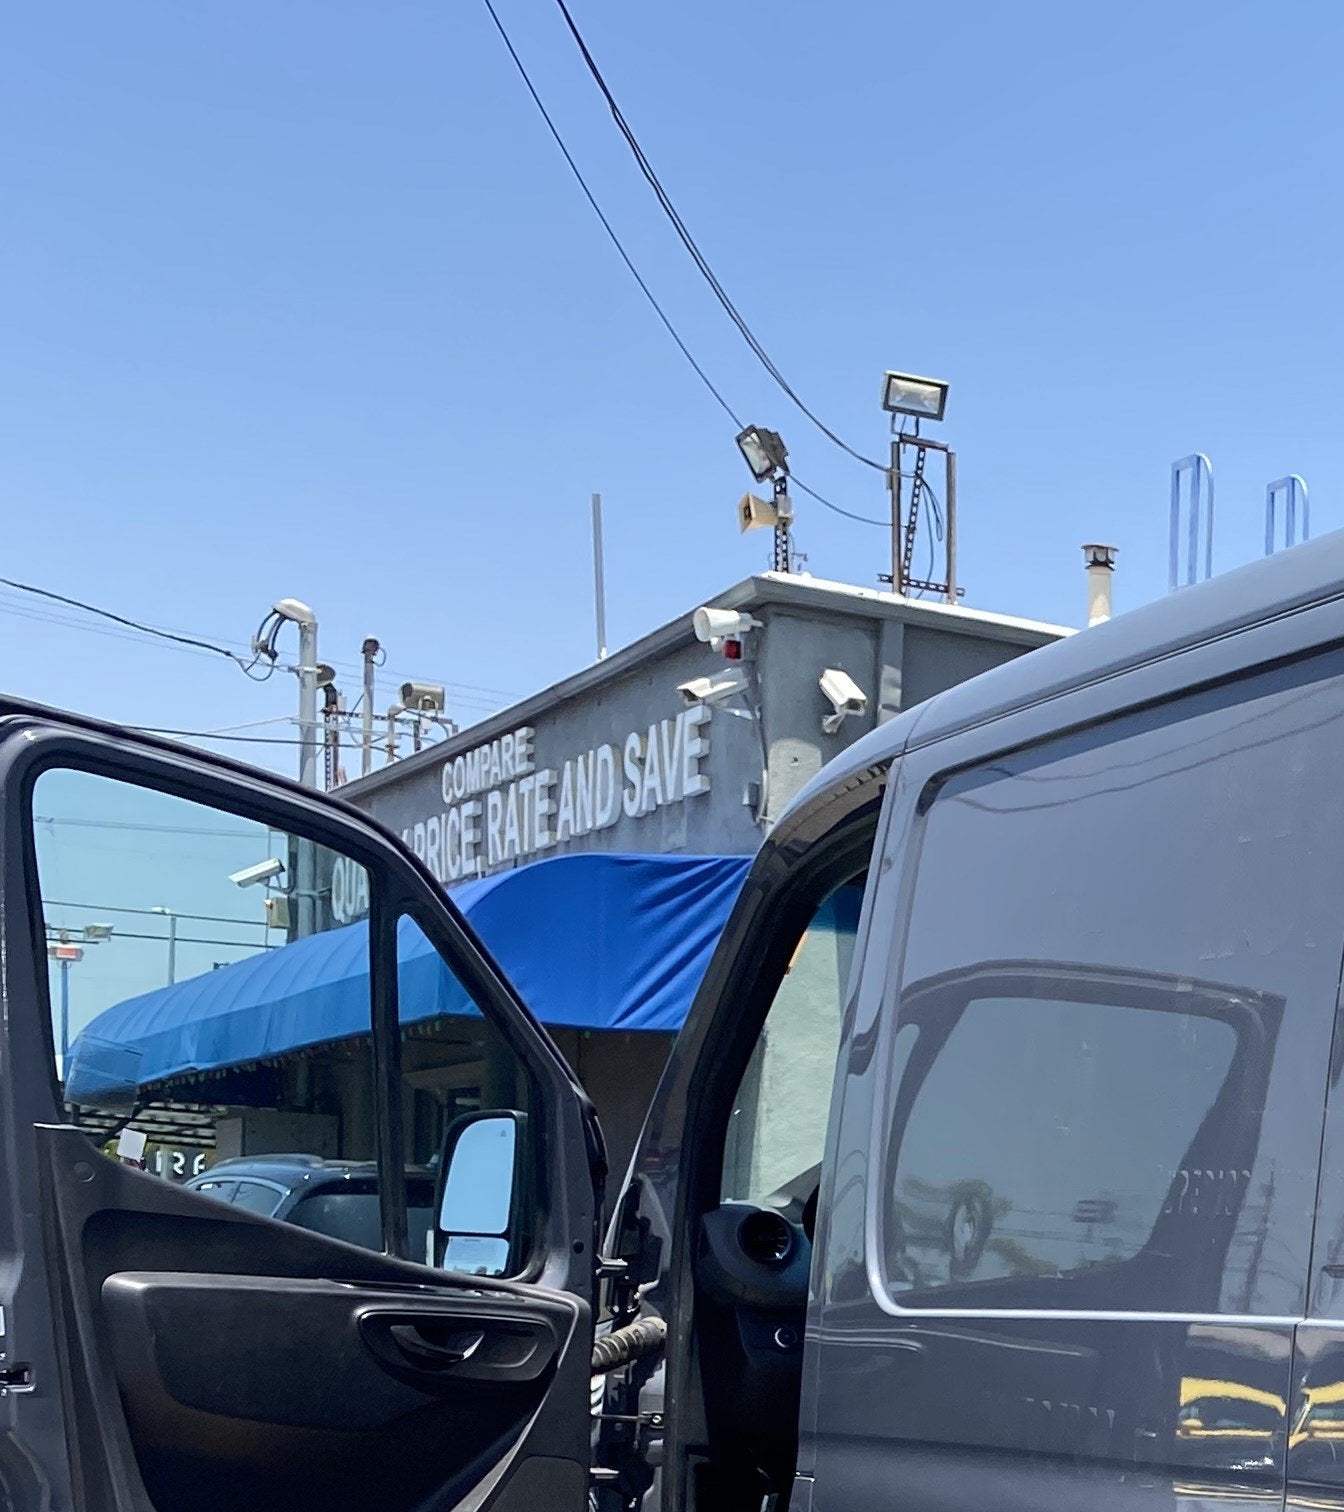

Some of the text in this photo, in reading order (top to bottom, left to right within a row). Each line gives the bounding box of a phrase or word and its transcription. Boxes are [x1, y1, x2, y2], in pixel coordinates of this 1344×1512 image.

[441, 725, 536, 805] COMPARE
[486, 768, 558, 867] RATE
[556, 742, 621, 843] AND
[621, 704, 712, 819] SAVE
